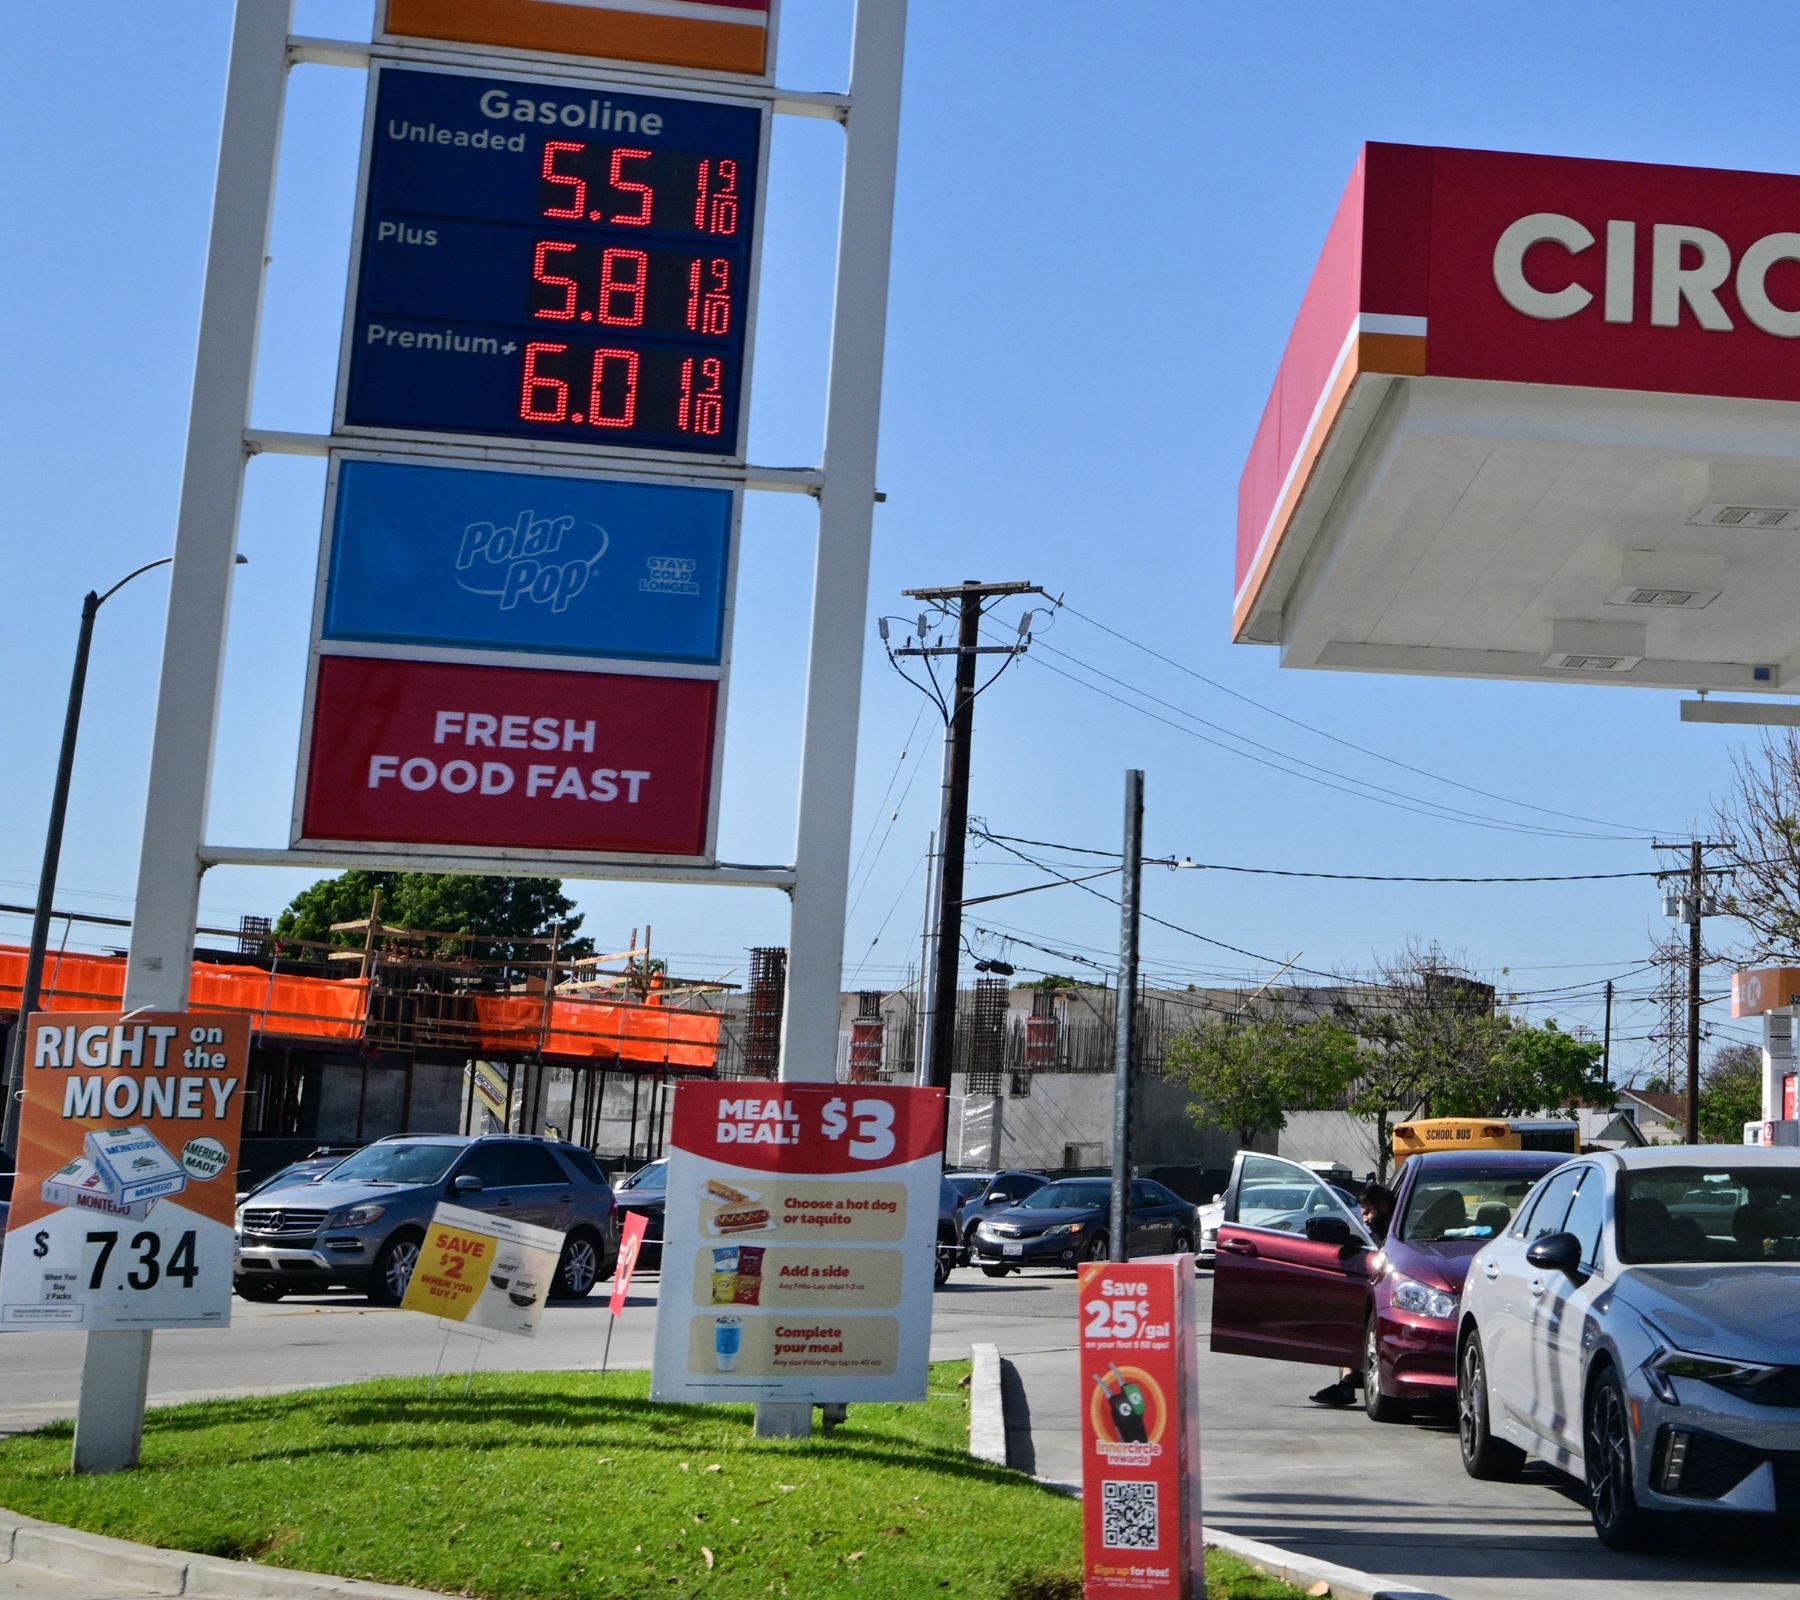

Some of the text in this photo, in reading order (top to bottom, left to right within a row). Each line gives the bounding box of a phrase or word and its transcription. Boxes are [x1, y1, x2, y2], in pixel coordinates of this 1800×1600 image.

[479, 89, 664, 136] Gasoline
[388, 119, 526, 153] Unleaded
[541, 140, 708, 231] 5.51
[377, 221, 438, 247] Plus
[533, 240, 702, 331] 5.81
[520, 342, 693, 433] 6.01
[455, 510, 575, 570] Polar
[648, 557, 696, 571] STAYS
[651, 570, 690, 581] COLD
[499, 559, 592, 614] Pop
[640, 579, 699, 594] LONGER
[433, 710, 597, 753] FRESH
[367, 755, 651, 804] FOOD FAST
[34, 1025, 223, 1069] RIGHT on
[183, 1046, 227, 1070] the
[62, 1075, 239, 1119] MONEY
[718, 1099, 799, 1121] MEAL
[716, 1096, 896, 1161] DEAL! $3
[1426, 1128, 1472, 1141] SCHOOL BUS
[105, 1141, 157, 1155] MONTEGO
[183, 1141, 229, 1166] AMERICAN
[184, 1156, 217, 1174] MADE
[134, 1181, 173, 1197] MONTEGO
[784, 1197, 897, 1213] Choose a hot dog
[783, 1212, 852, 1227] or taquito
[435, 1234, 485, 1258] SAVE
[33, 1229, 199, 1291] $ 7.34
[440, 1253, 466, 1280] $2
[64, 1273, 78, 1281] You
[779, 1265, 850, 1277] Add a side
[53, 1283, 66, 1291] Buy
[421, 1274, 473, 1294] WHEN YOU
[794, 1283, 826, 1291] Frito-Lay
[826, 1283, 845, 1291] chips
[1101, 1279, 1148, 1296] Save
[430, 1287, 458, 1300] BUY 2
[775, 1326, 842, 1340] Complete
[774, 1341, 843, 1356] your meal
[1085, 1340, 1170, 1350] on your first 5 fill ups!
[823, 1359, 838, 1367] Pop
[1097, 1441, 1160, 1455] innercircle
[1110, 1454, 1149, 1464] rewards
[1093, 1564, 1170, 1577] Sign up for free!
